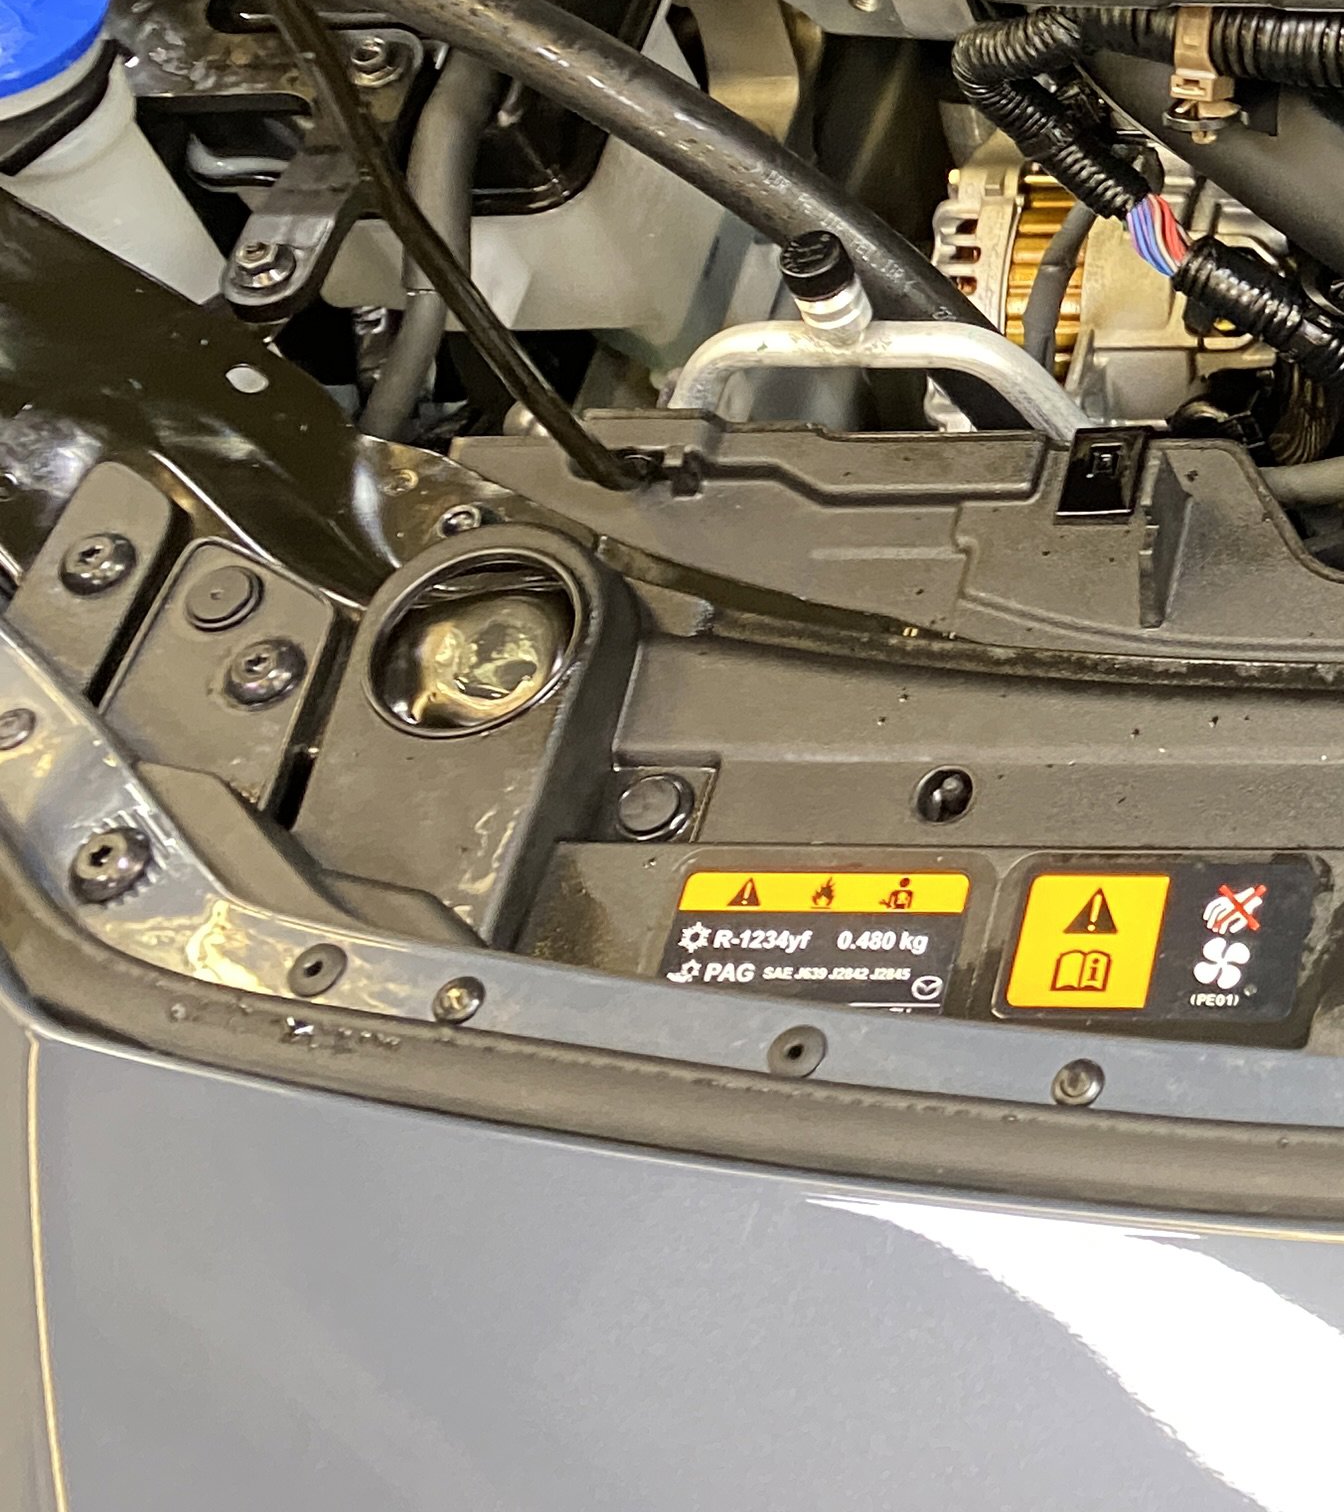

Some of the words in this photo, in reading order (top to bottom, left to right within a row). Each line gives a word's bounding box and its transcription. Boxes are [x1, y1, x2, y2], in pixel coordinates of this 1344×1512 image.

[713, 929, 812, 953] R-1234yf
[836, 931, 897, 951] 0.480
[899, 931, 929, 955] kg
[703, 962, 756, 983] PAG
[762, 966, 793, 980] SAE
[794, 967, 828, 981] J639
[828, 967, 869, 981] J2842
[1190, 992, 1240, 1007] (PE01)
